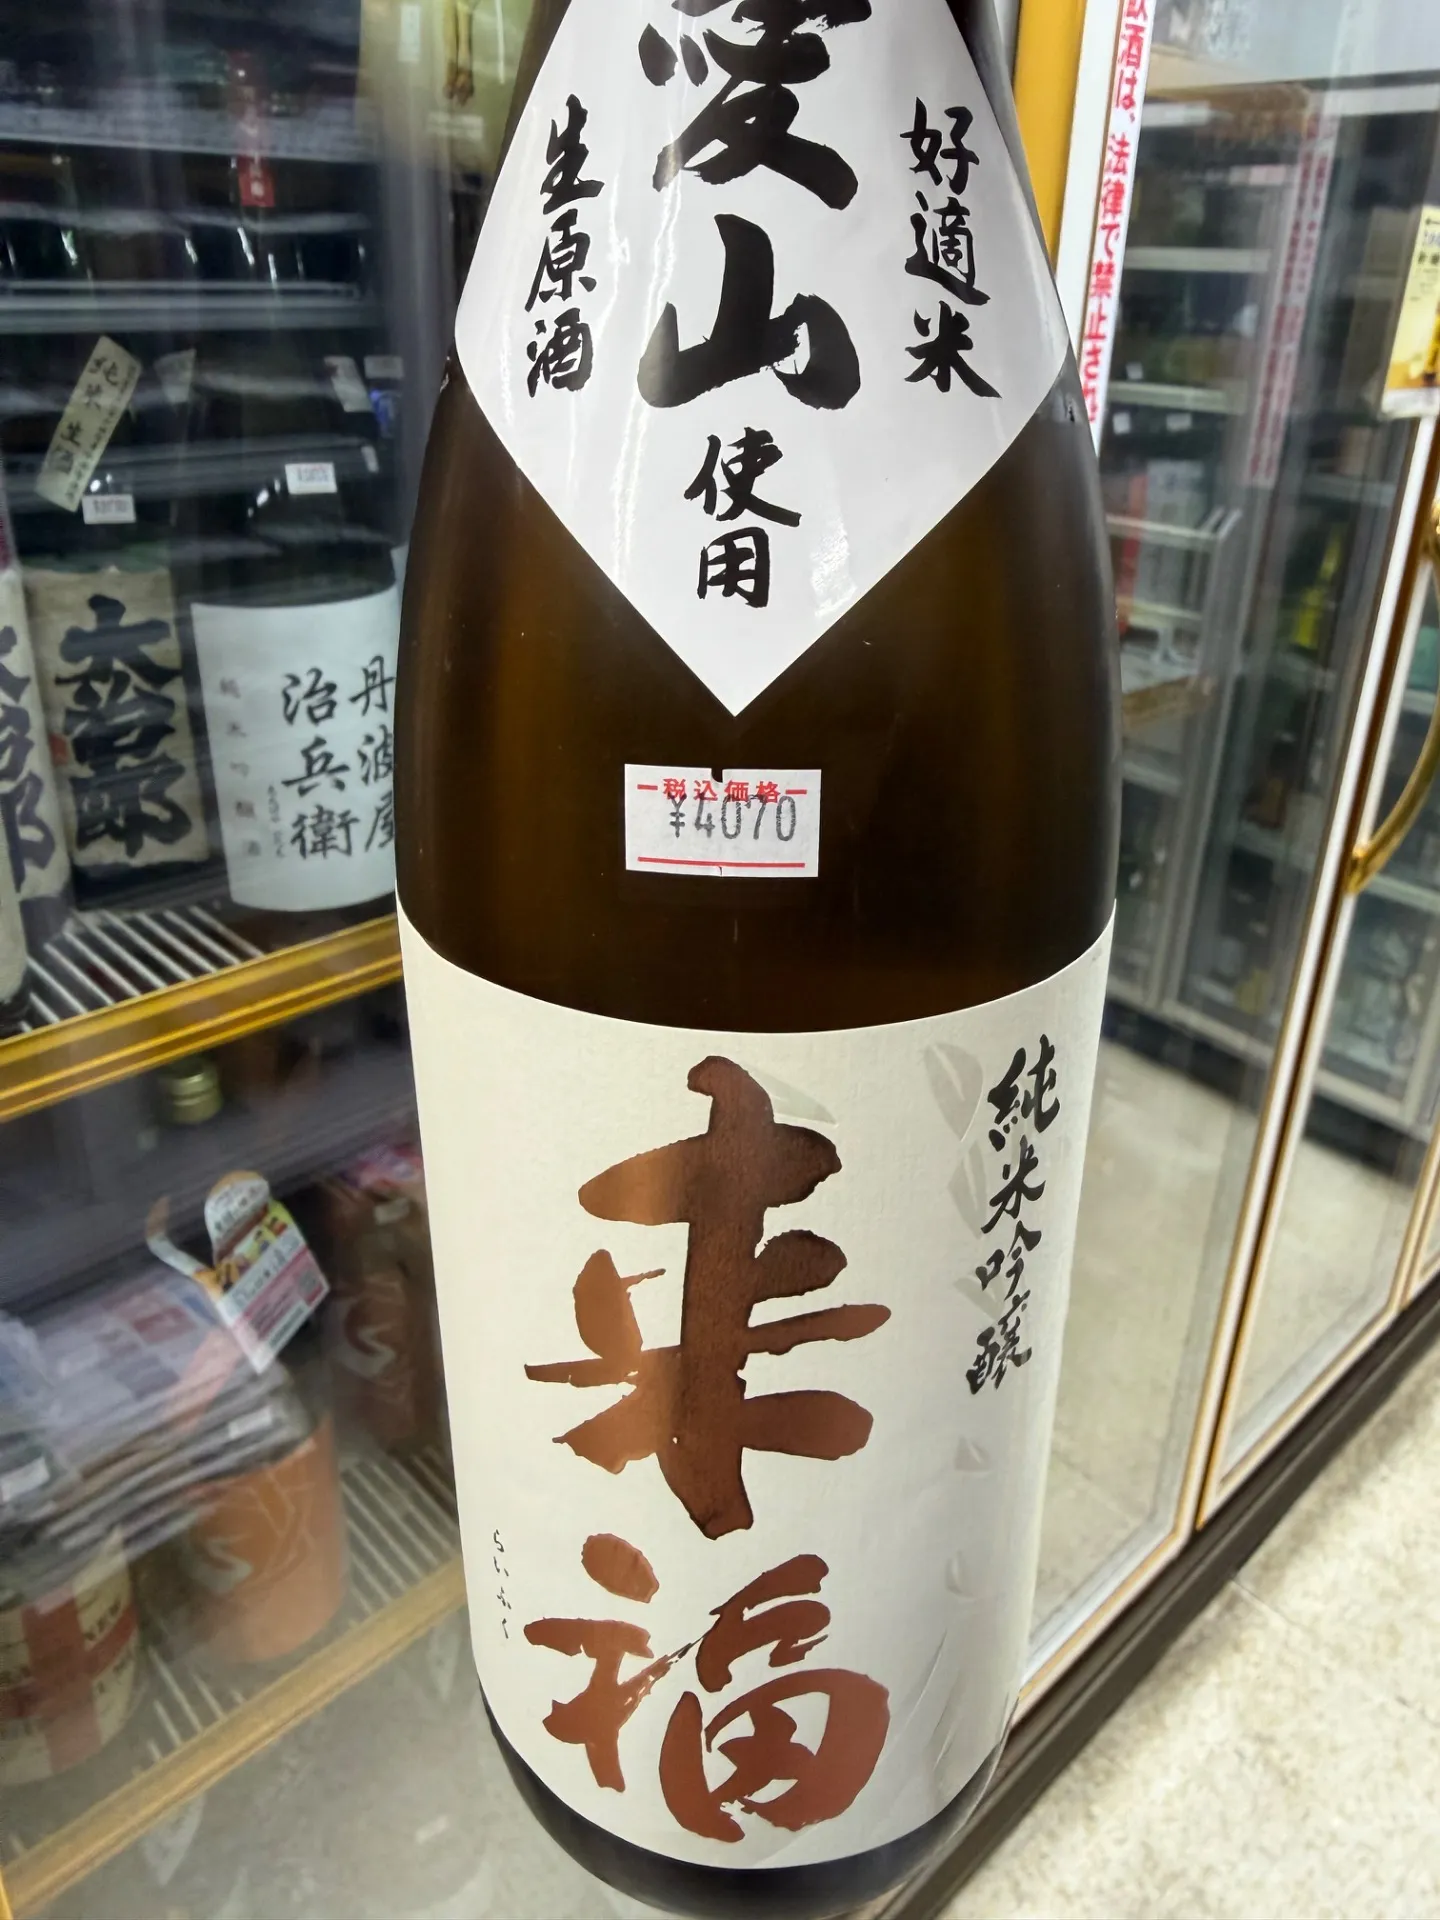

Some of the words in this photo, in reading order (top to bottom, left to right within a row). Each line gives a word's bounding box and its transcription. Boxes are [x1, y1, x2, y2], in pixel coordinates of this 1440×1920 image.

[525, 95, 604, 398] 生原酒
[900, 98, 1002, 398] 好適米
[684, 427, 801, 608] 使用
[282, 667, 361, 859] 治兵衛
[663, 778, 781, 804] 税込価格
[667, 794, 797, 842] ¥4070
[966, 1033, 1060, 1395] 純米吟醸
[524, 1055, 892, 1843] 来福
[493, 1528, 512, 1640] らいふく
